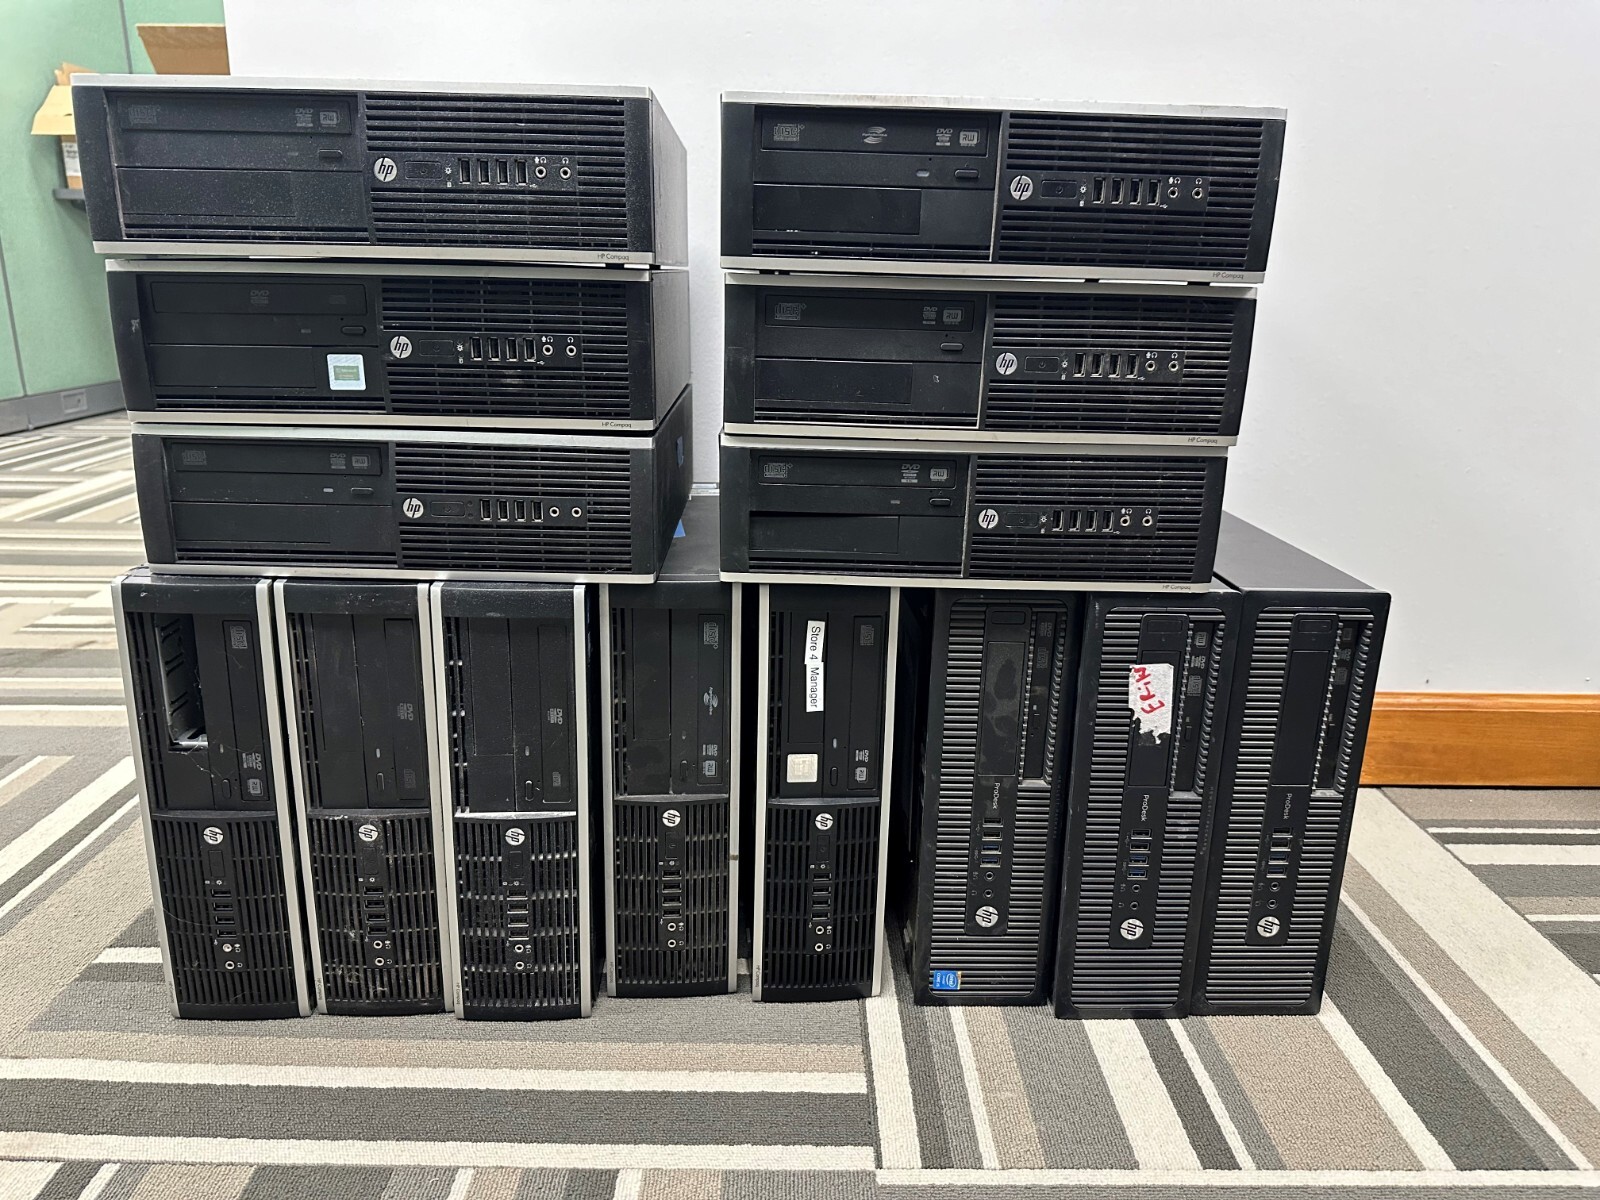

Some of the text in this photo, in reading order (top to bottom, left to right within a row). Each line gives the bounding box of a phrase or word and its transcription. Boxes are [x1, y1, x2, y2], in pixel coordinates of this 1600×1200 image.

[374, 158, 397, 182] hp
[1010, 176, 1033, 200] hp
[390, 336, 412, 358] hp
[996, 352, 1018, 374] hp
[402, 498, 424, 518] hp
[978, 509, 998, 529] hp
[810, 626, 821, 651] Store
[809, 667, 820, 708] Manager
[992, 782, 1000, 809] ProDesk
[1283, 793, 1293, 820] ProDesk
[663, 810, 680, 827] hp
[1140, 794, 1150, 822] ProDesk
[815, 813, 833, 830] hp
[204, 827, 224, 844] hp
[358, 824, 378, 842] hp
[505, 828, 525, 846] hp
[976, 906, 998, 928] hp
[1256, 916, 1280, 937] hp
[1120, 918, 1144, 940] hp
